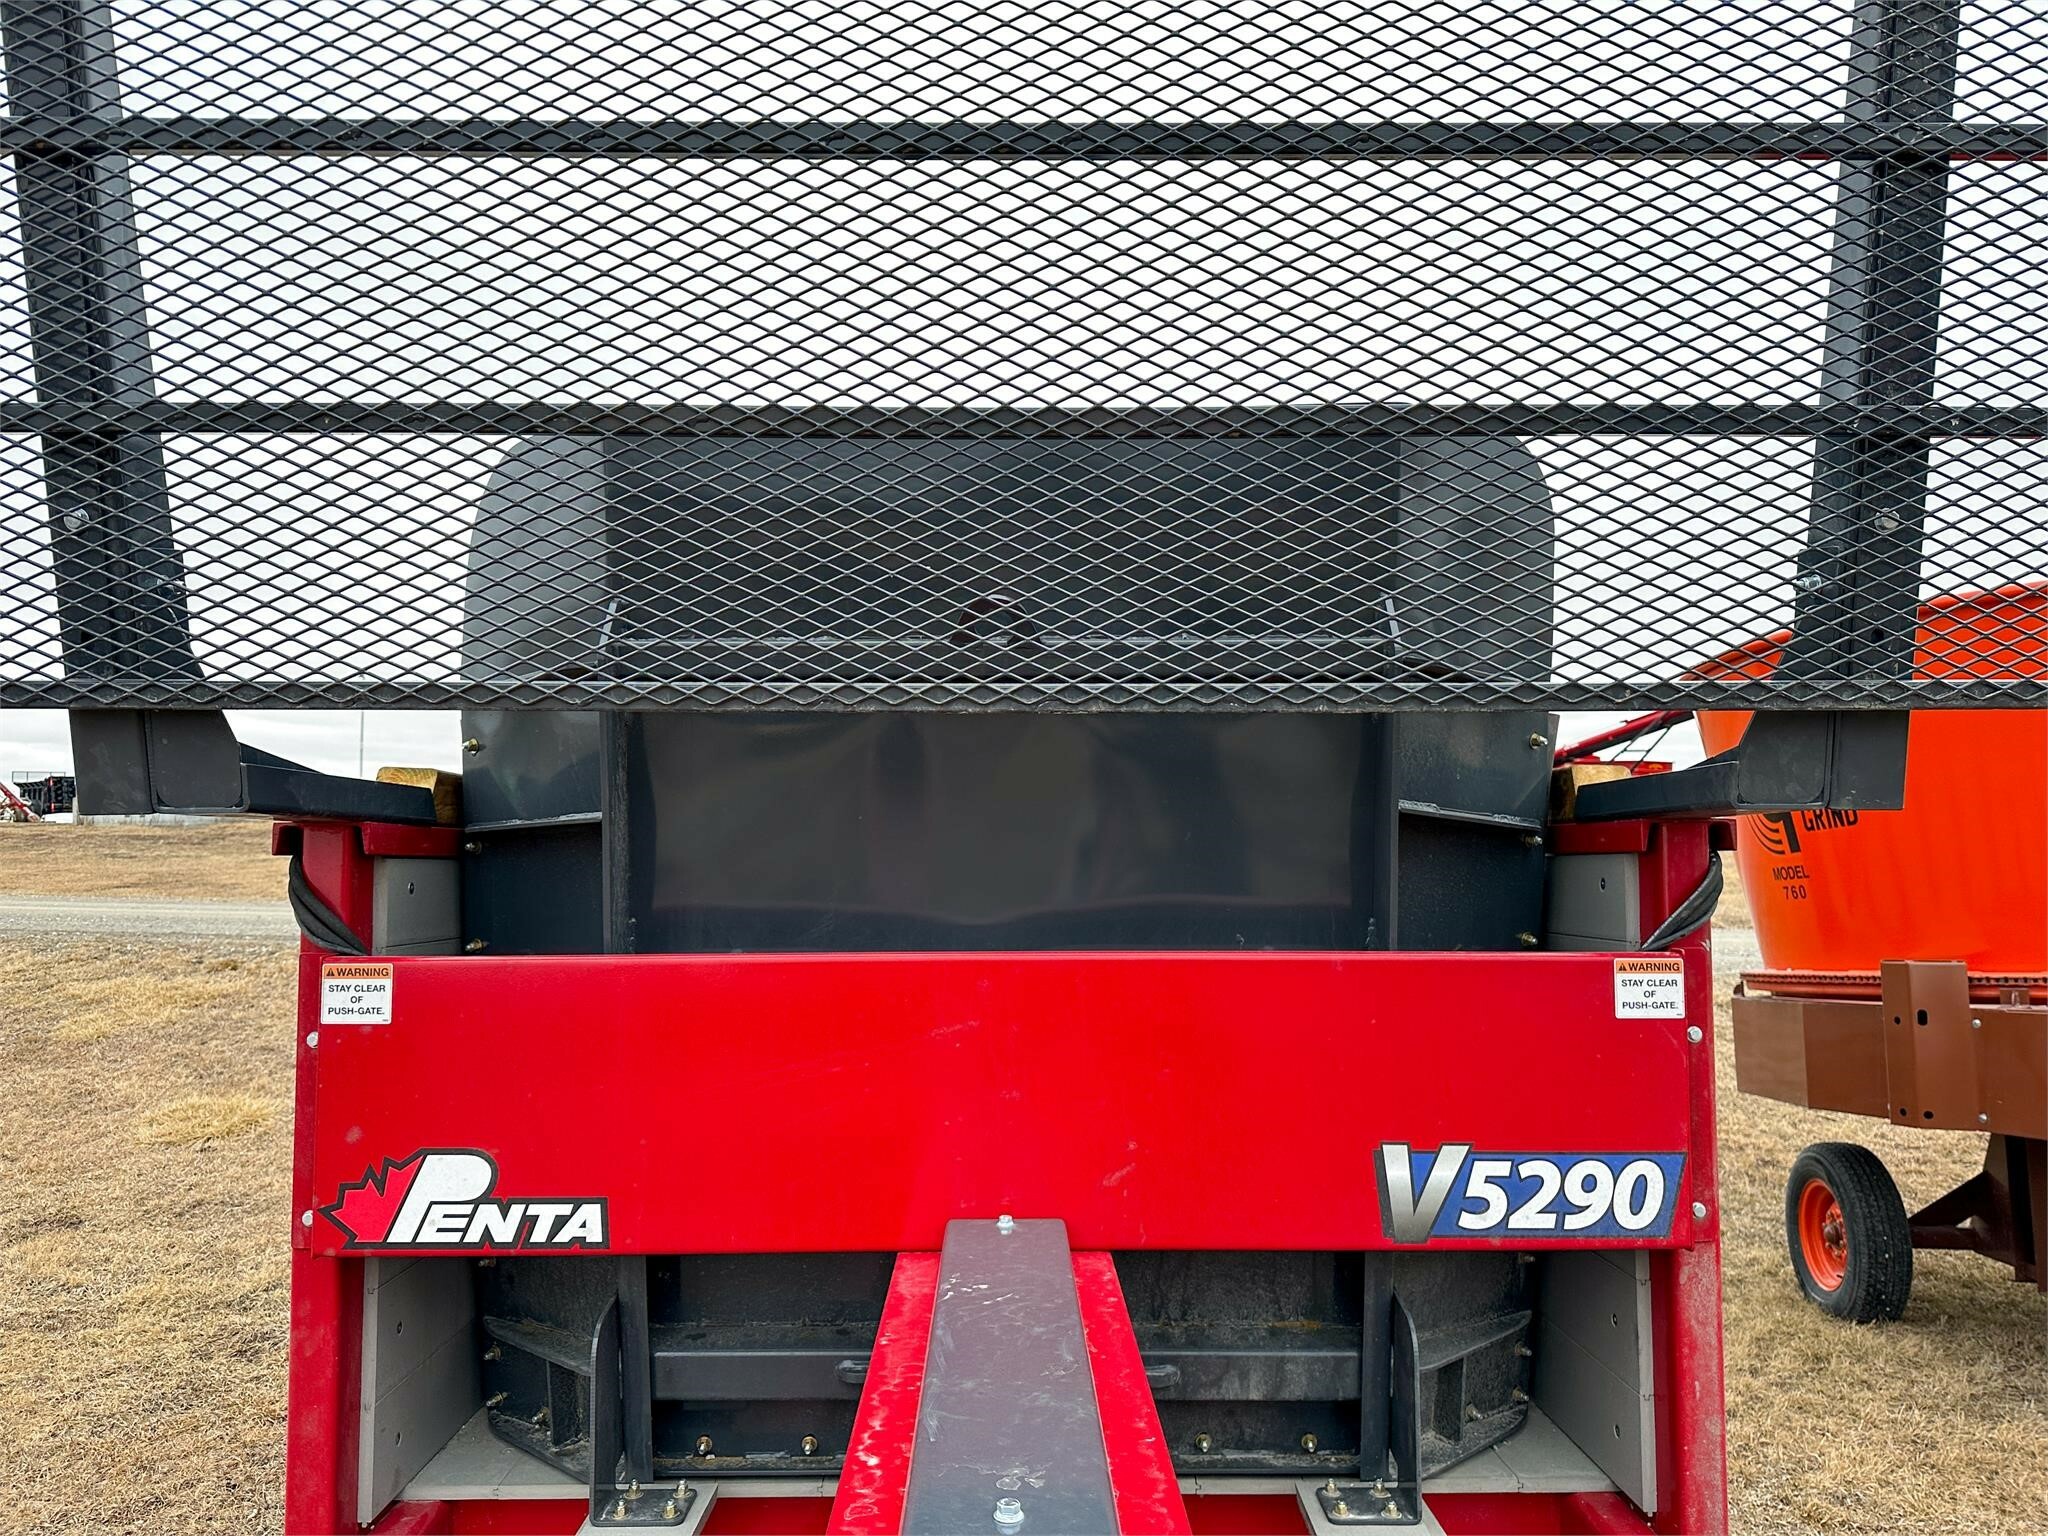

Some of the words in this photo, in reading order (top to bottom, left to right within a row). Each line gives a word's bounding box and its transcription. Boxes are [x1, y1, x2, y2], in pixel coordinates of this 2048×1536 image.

[1801, 808, 1859, 832] GRIND
[1772, 865, 1810, 881] MODEL
[1783, 884, 1807, 900] 760
[337, 967, 389, 977] WARNING
[1628, 962, 1680, 972] WARNING
[1621, 979, 1644, 987] STAY
[1646, 979, 1678, 987] CLEAR
[328, 984, 352, 993] STAY
[354, 984, 386, 993] CLEAR
[1643, 990, 1656, 998] OF
[350, 995, 364, 1004] OF
[1622, 1001, 1679, 1010] PUSH-GATE.
[328, 1007, 385, 1015] PUSH-GATE.
[1380, 1142, 1666, 1243] V5290
[385, 1153, 604, 1243] PENTA
